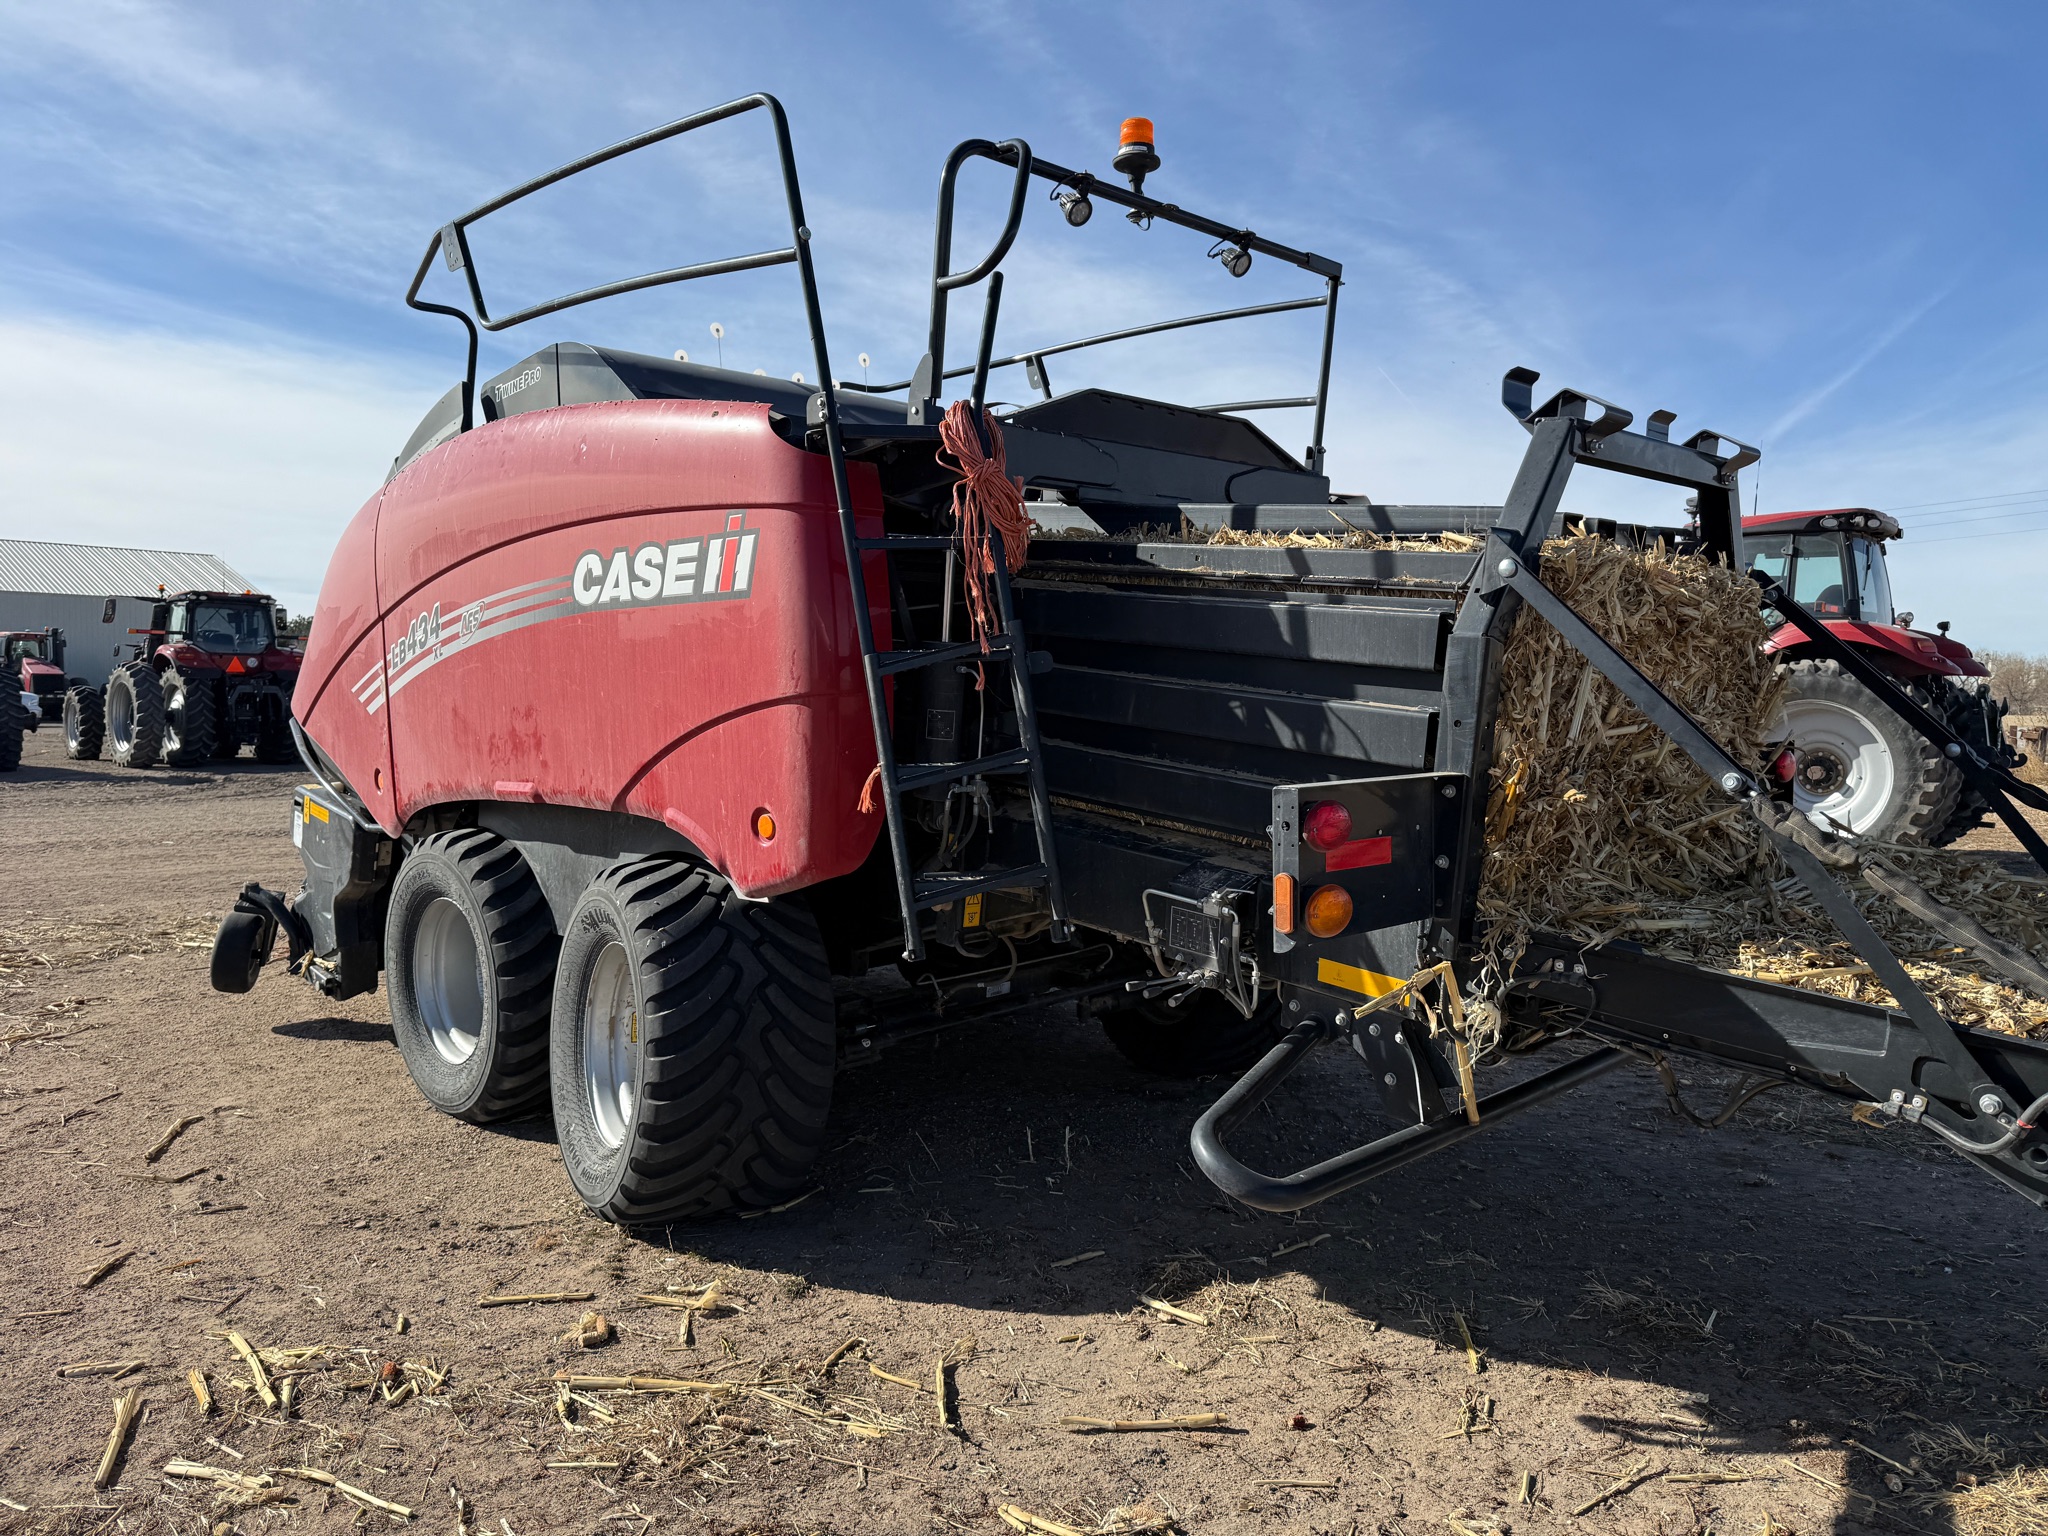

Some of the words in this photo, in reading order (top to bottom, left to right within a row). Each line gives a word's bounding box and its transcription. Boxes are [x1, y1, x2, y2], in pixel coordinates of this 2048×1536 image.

[573, 553, 700, 607] CASE
[702, 513, 756, 595] IH
[391, 601, 440, 670] LB434
[460, 604, 483, 638] AFS
[432, 643, 443, 660] XL
